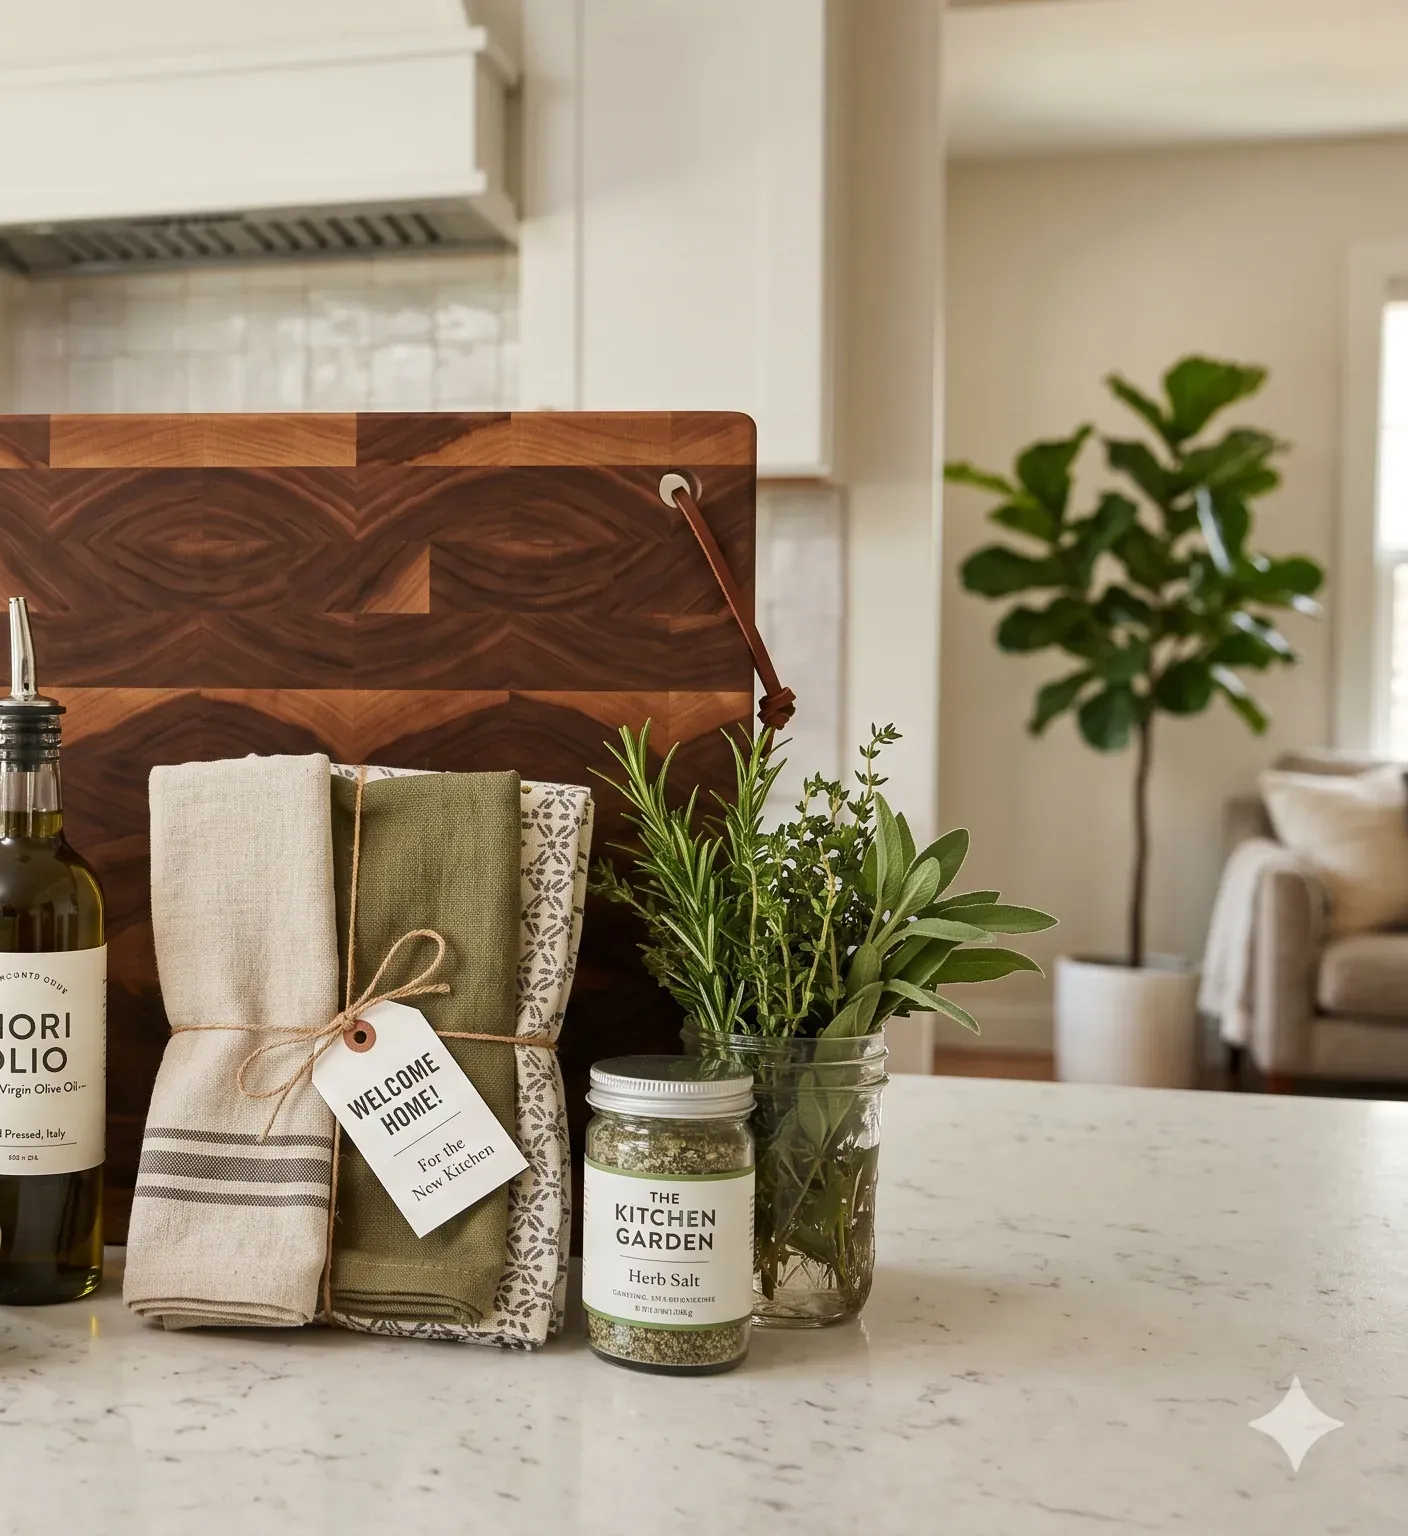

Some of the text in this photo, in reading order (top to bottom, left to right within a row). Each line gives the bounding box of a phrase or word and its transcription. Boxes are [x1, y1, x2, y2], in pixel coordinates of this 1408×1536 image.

[34, 1083, 62, 1095] Olive
[346, 1052, 441, 1121] WELCOME
[380, 1085, 444, 1137] HOME!
[5, 1128, 44, 1140] Pressed,
[46, 1127, 66, 1141] Italy
[417, 1138, 466, 1173] For the
[411, 1144, 496, 1202] New Kitchen
[649, 1191, 680, 1205] THE
[615, 1203, 716, 1228] KITCHEN
[615, 1227, 714, 1251] GARDEN
[628, 1268, 701, 1288] Herb Salt
